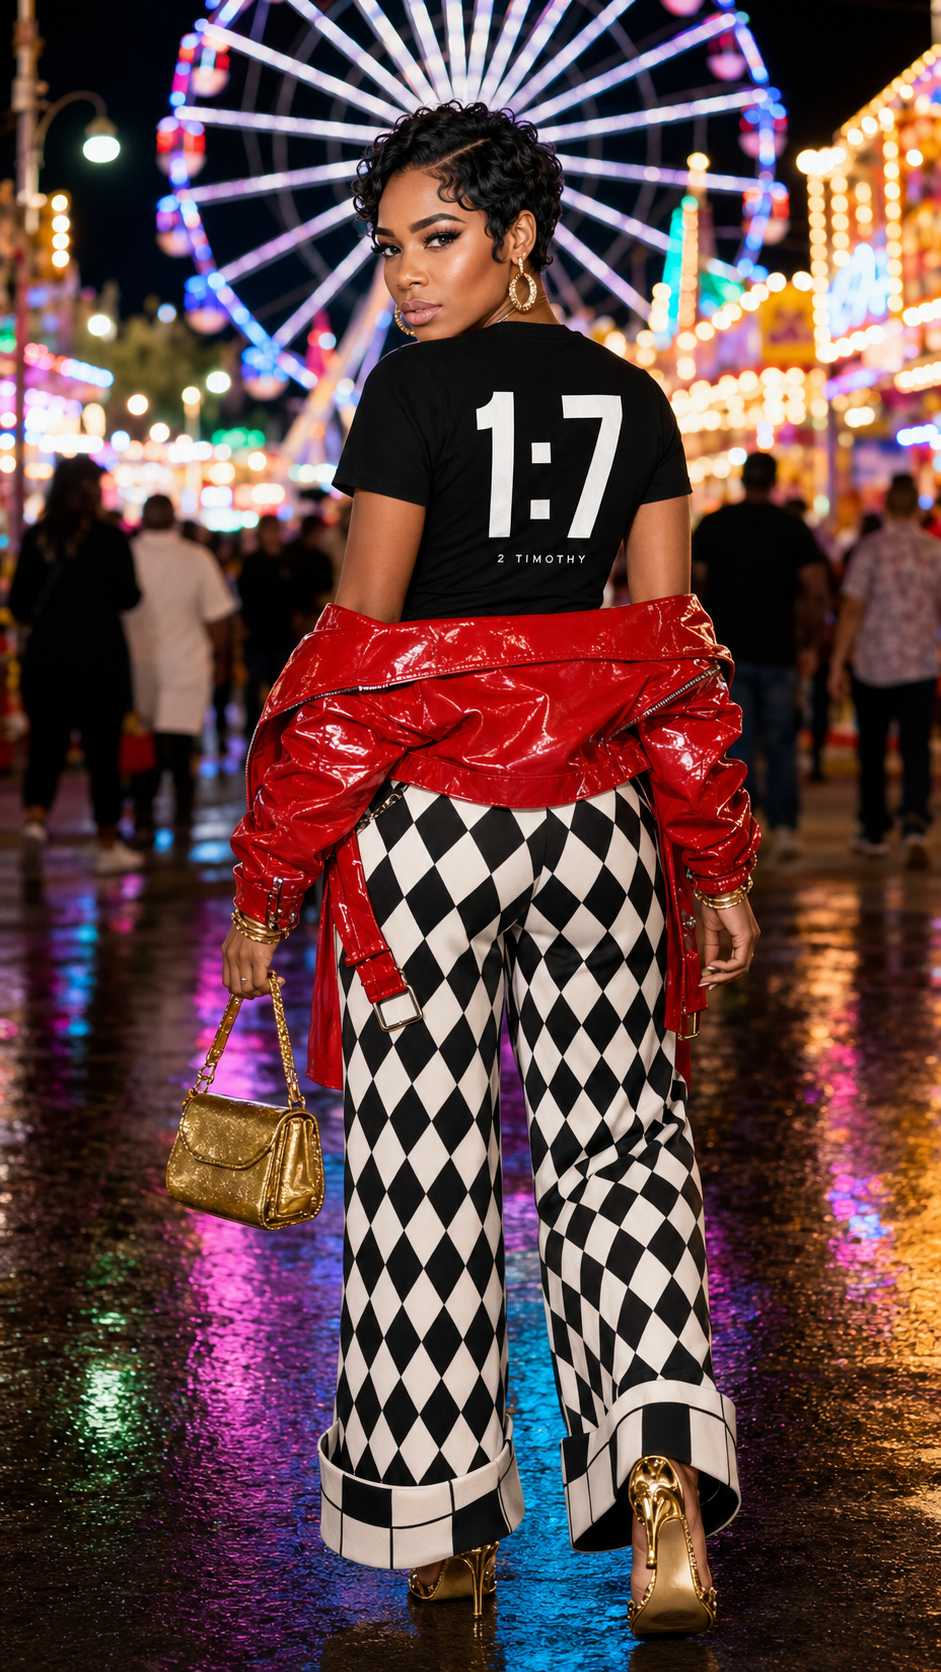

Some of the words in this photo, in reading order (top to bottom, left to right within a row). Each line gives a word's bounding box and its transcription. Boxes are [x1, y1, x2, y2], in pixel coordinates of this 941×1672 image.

[476, 391, 623, 538] 1:7
[497, 554, 505, 563] 2
[515, 554, 586, 564] TIMOTHY
